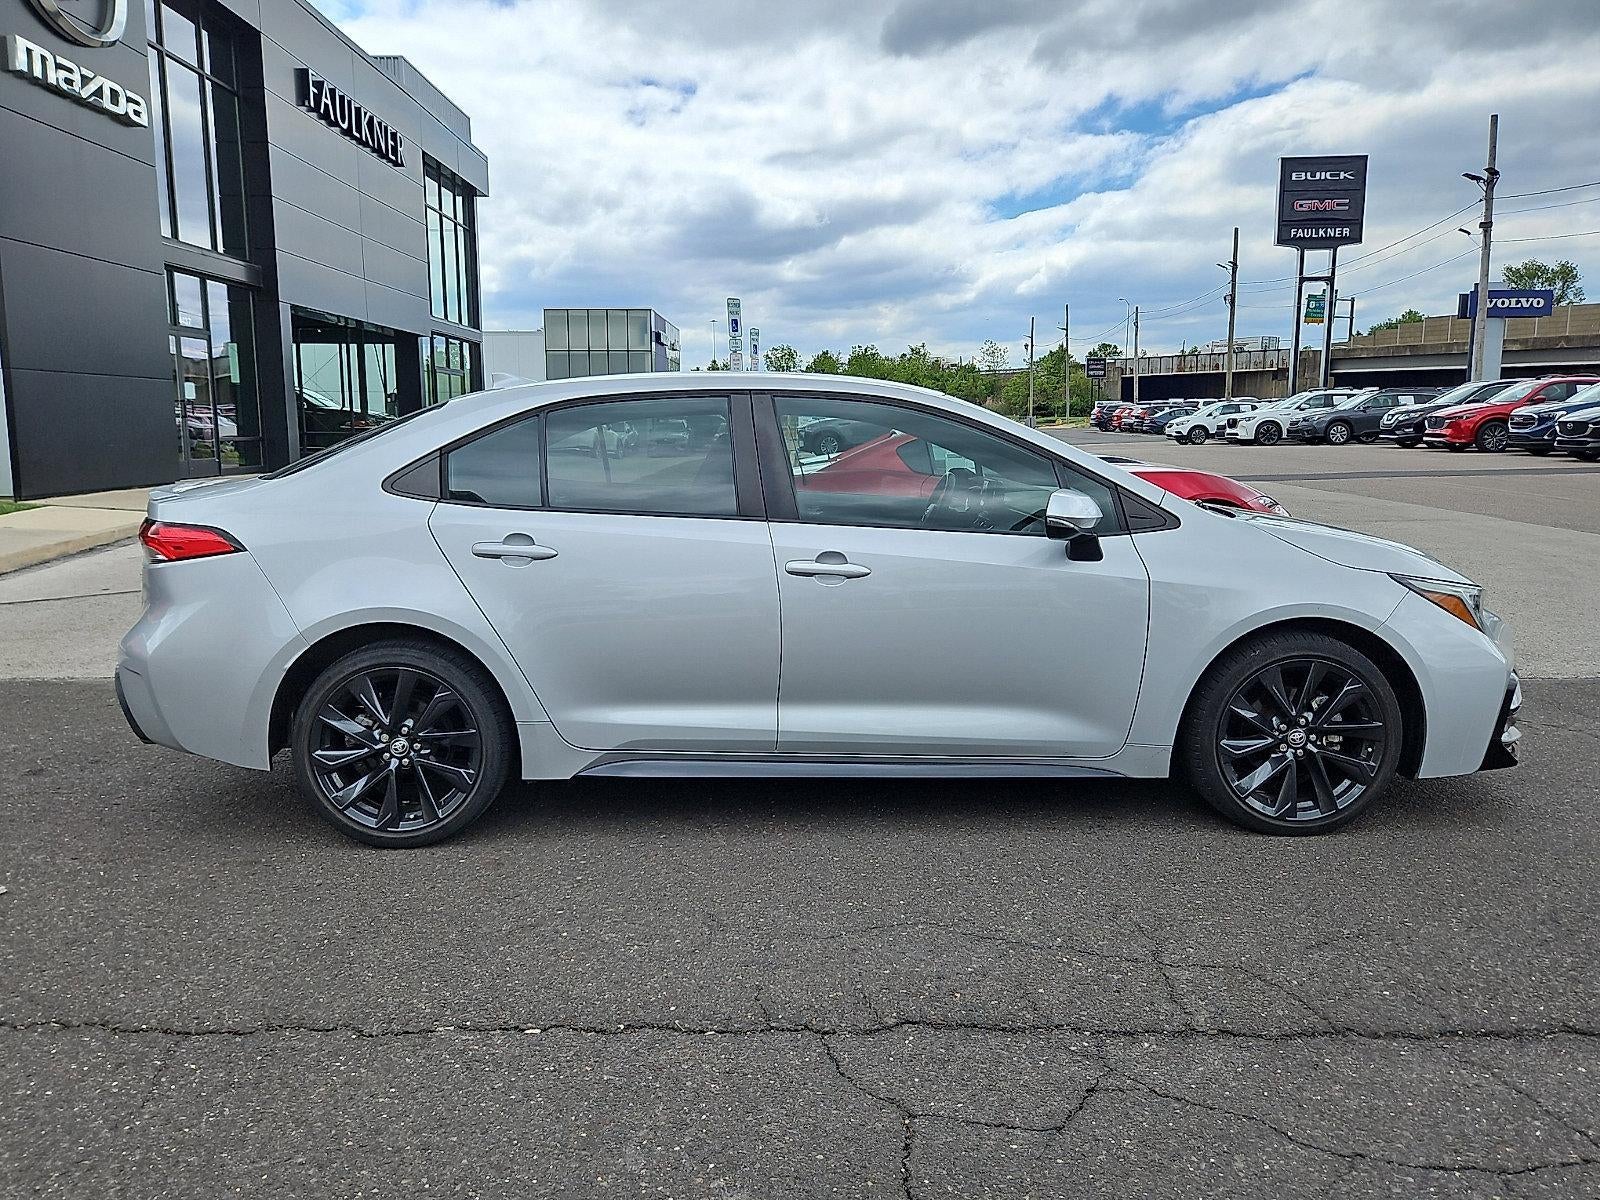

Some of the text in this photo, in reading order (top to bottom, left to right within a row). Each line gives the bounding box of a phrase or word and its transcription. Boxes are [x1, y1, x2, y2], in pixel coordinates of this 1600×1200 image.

[308, 68, 406, 167] FAULKNER
[1291, 171, 1355, 181] BUICK
[1293, 199, 1350, 212] GMC
[1290, 227, 1350, 238] FAULKNER
[1486, 298, 1545, 308] VOLVO
